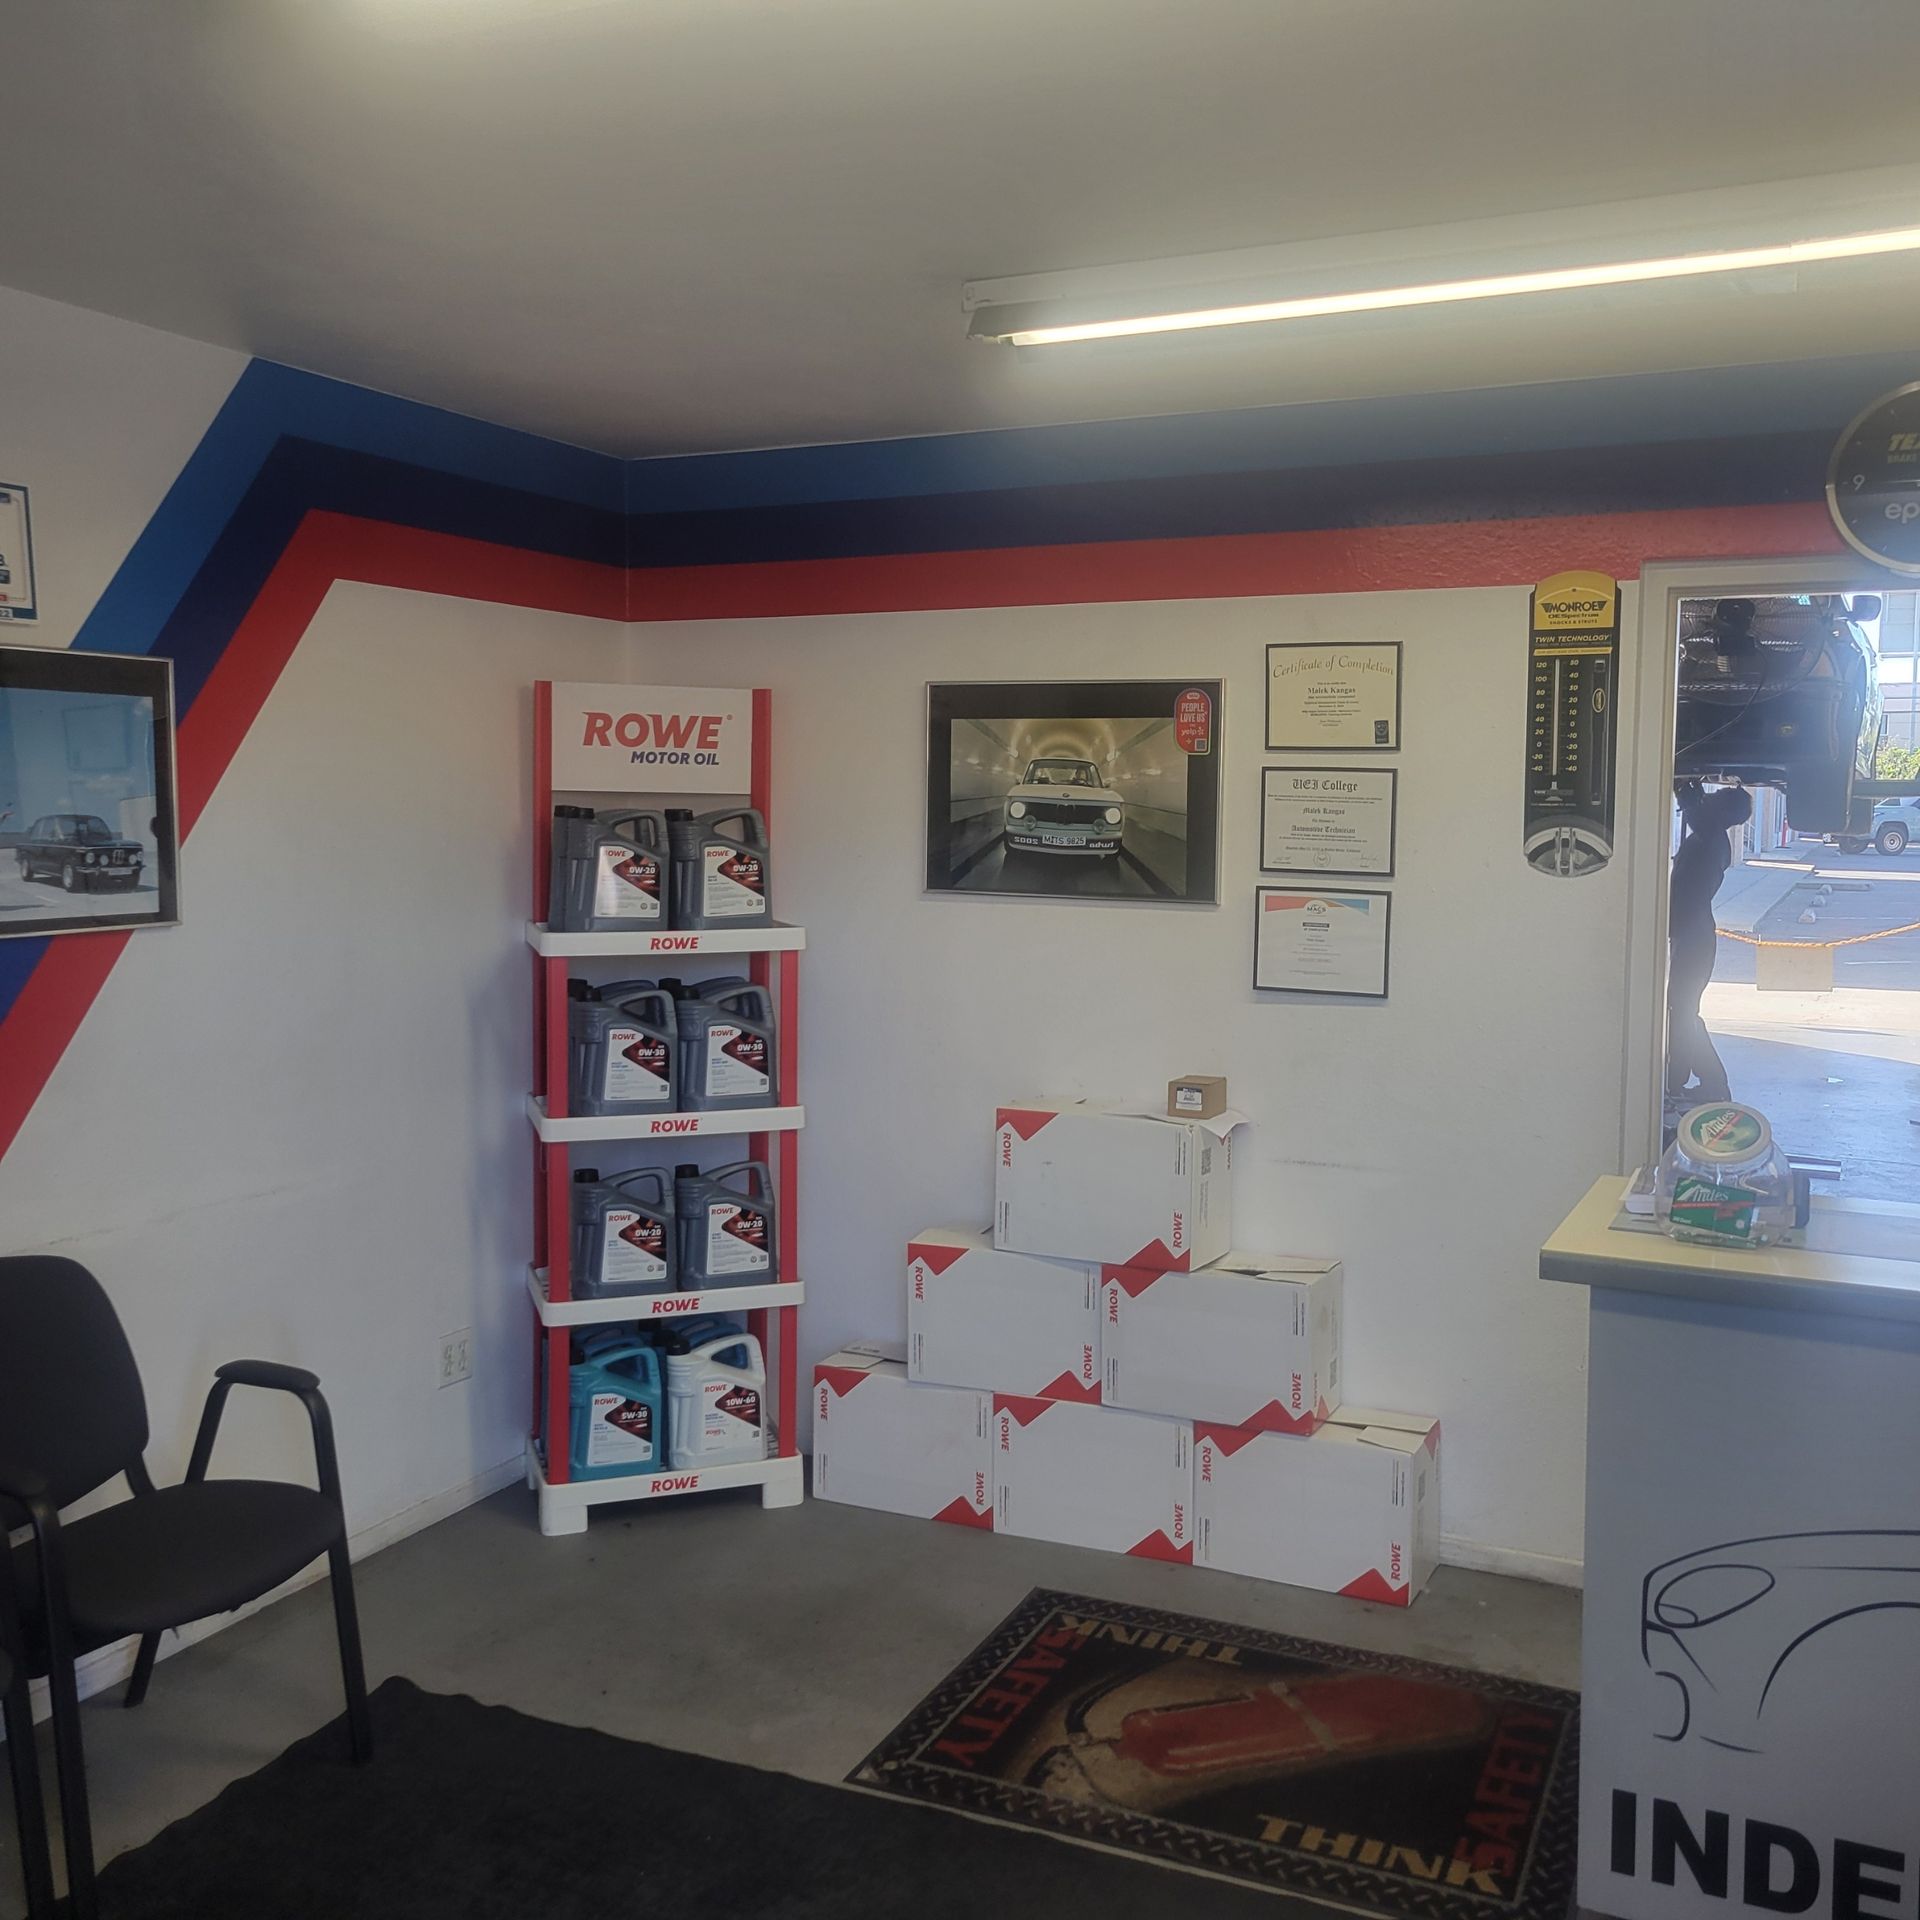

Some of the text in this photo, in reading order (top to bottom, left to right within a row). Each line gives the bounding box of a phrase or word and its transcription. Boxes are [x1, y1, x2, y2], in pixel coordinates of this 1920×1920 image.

[1852, 474, 1865, 491] 9
[1549, 601, 1598, 613] MONROE
[1557, 634, 1609, 642] TECHNOLOGY
[1273, 655, 1394, 679] Certificate of Completion
[1181, 702, 1204, 712] PEOPLE
[1180, 712, 1206, 723] LOVE US
[582, 711, 724, 750] ROWE
[1181, 728, 1197, 736] yelp
[630, 751, 720, 766] MOTOR OIL
[1321, 780, 1358, 793] College
[1324, 826, 1356, 834] Technician
[706, 849, 731, 858] ROWE
[629, 866, 656, 874] 0W-20
[733, 864, 758, 872] 0W-20
[650, 936, 699, 950] ROWE
[612, 1033, 636, 1041] ROWE
[711, 1029, 734, 1037] ROWE
[638, 1048, 665, 1057] 0W-30
[737, 1043, 763, 1052] 0W-30
[651, 1119, 699, 1133] ROWE
[1700, 1110, 1736, 1147] Andes
[1003, 1132, 1012, 1168] ROWE
[1676, 1184, 1729, 1202] Andes
[608, 1214, 632, 1222] ROWE
[711, 1206, 734, 1215] ROWE
[737, 1220, 763, 1229] 0W-20
[1173, 1212, 1183, 1248] ROWE
[635, 1228, 662, 1237] 0W-20
[915, 1266, 924, 1301] ROWE
[652, 1298, 700, 1313] ROWE
[1109, 1287, 1119, 1324] ROWE
[1083, 1344, 1093, 1380] ROWE
[704, 1384, 727, 1393] ROWE
[1292, 1373, 1302, 1409] ROWE
[594, 1397, 618, 1406] ROWE
[820, 1387, 828, 1421] ROWE
[621, 1410, 648, 1420] 5W-30
[1001, 1416, 1010, 1452] ROWE
[1202, 1446, 1211, 1483] ROWE
[651, 1475, 699, 1493] ROWE
[976, 1471, 985, 1506] ROWE
[1174, 1503, 1184, 1540] ROWE
[1391, 1543, 1401, 1581] ROWE
[1058, 1613, 1246, 1666] THINK
[934, 1627, 1090, 1767] SAFETY
[1450, 1708, 1559, 1876] SAFETY
[1257, 1813, 1501, 1894] THINK
[1610, 1788, 1920, 1920] INDE
